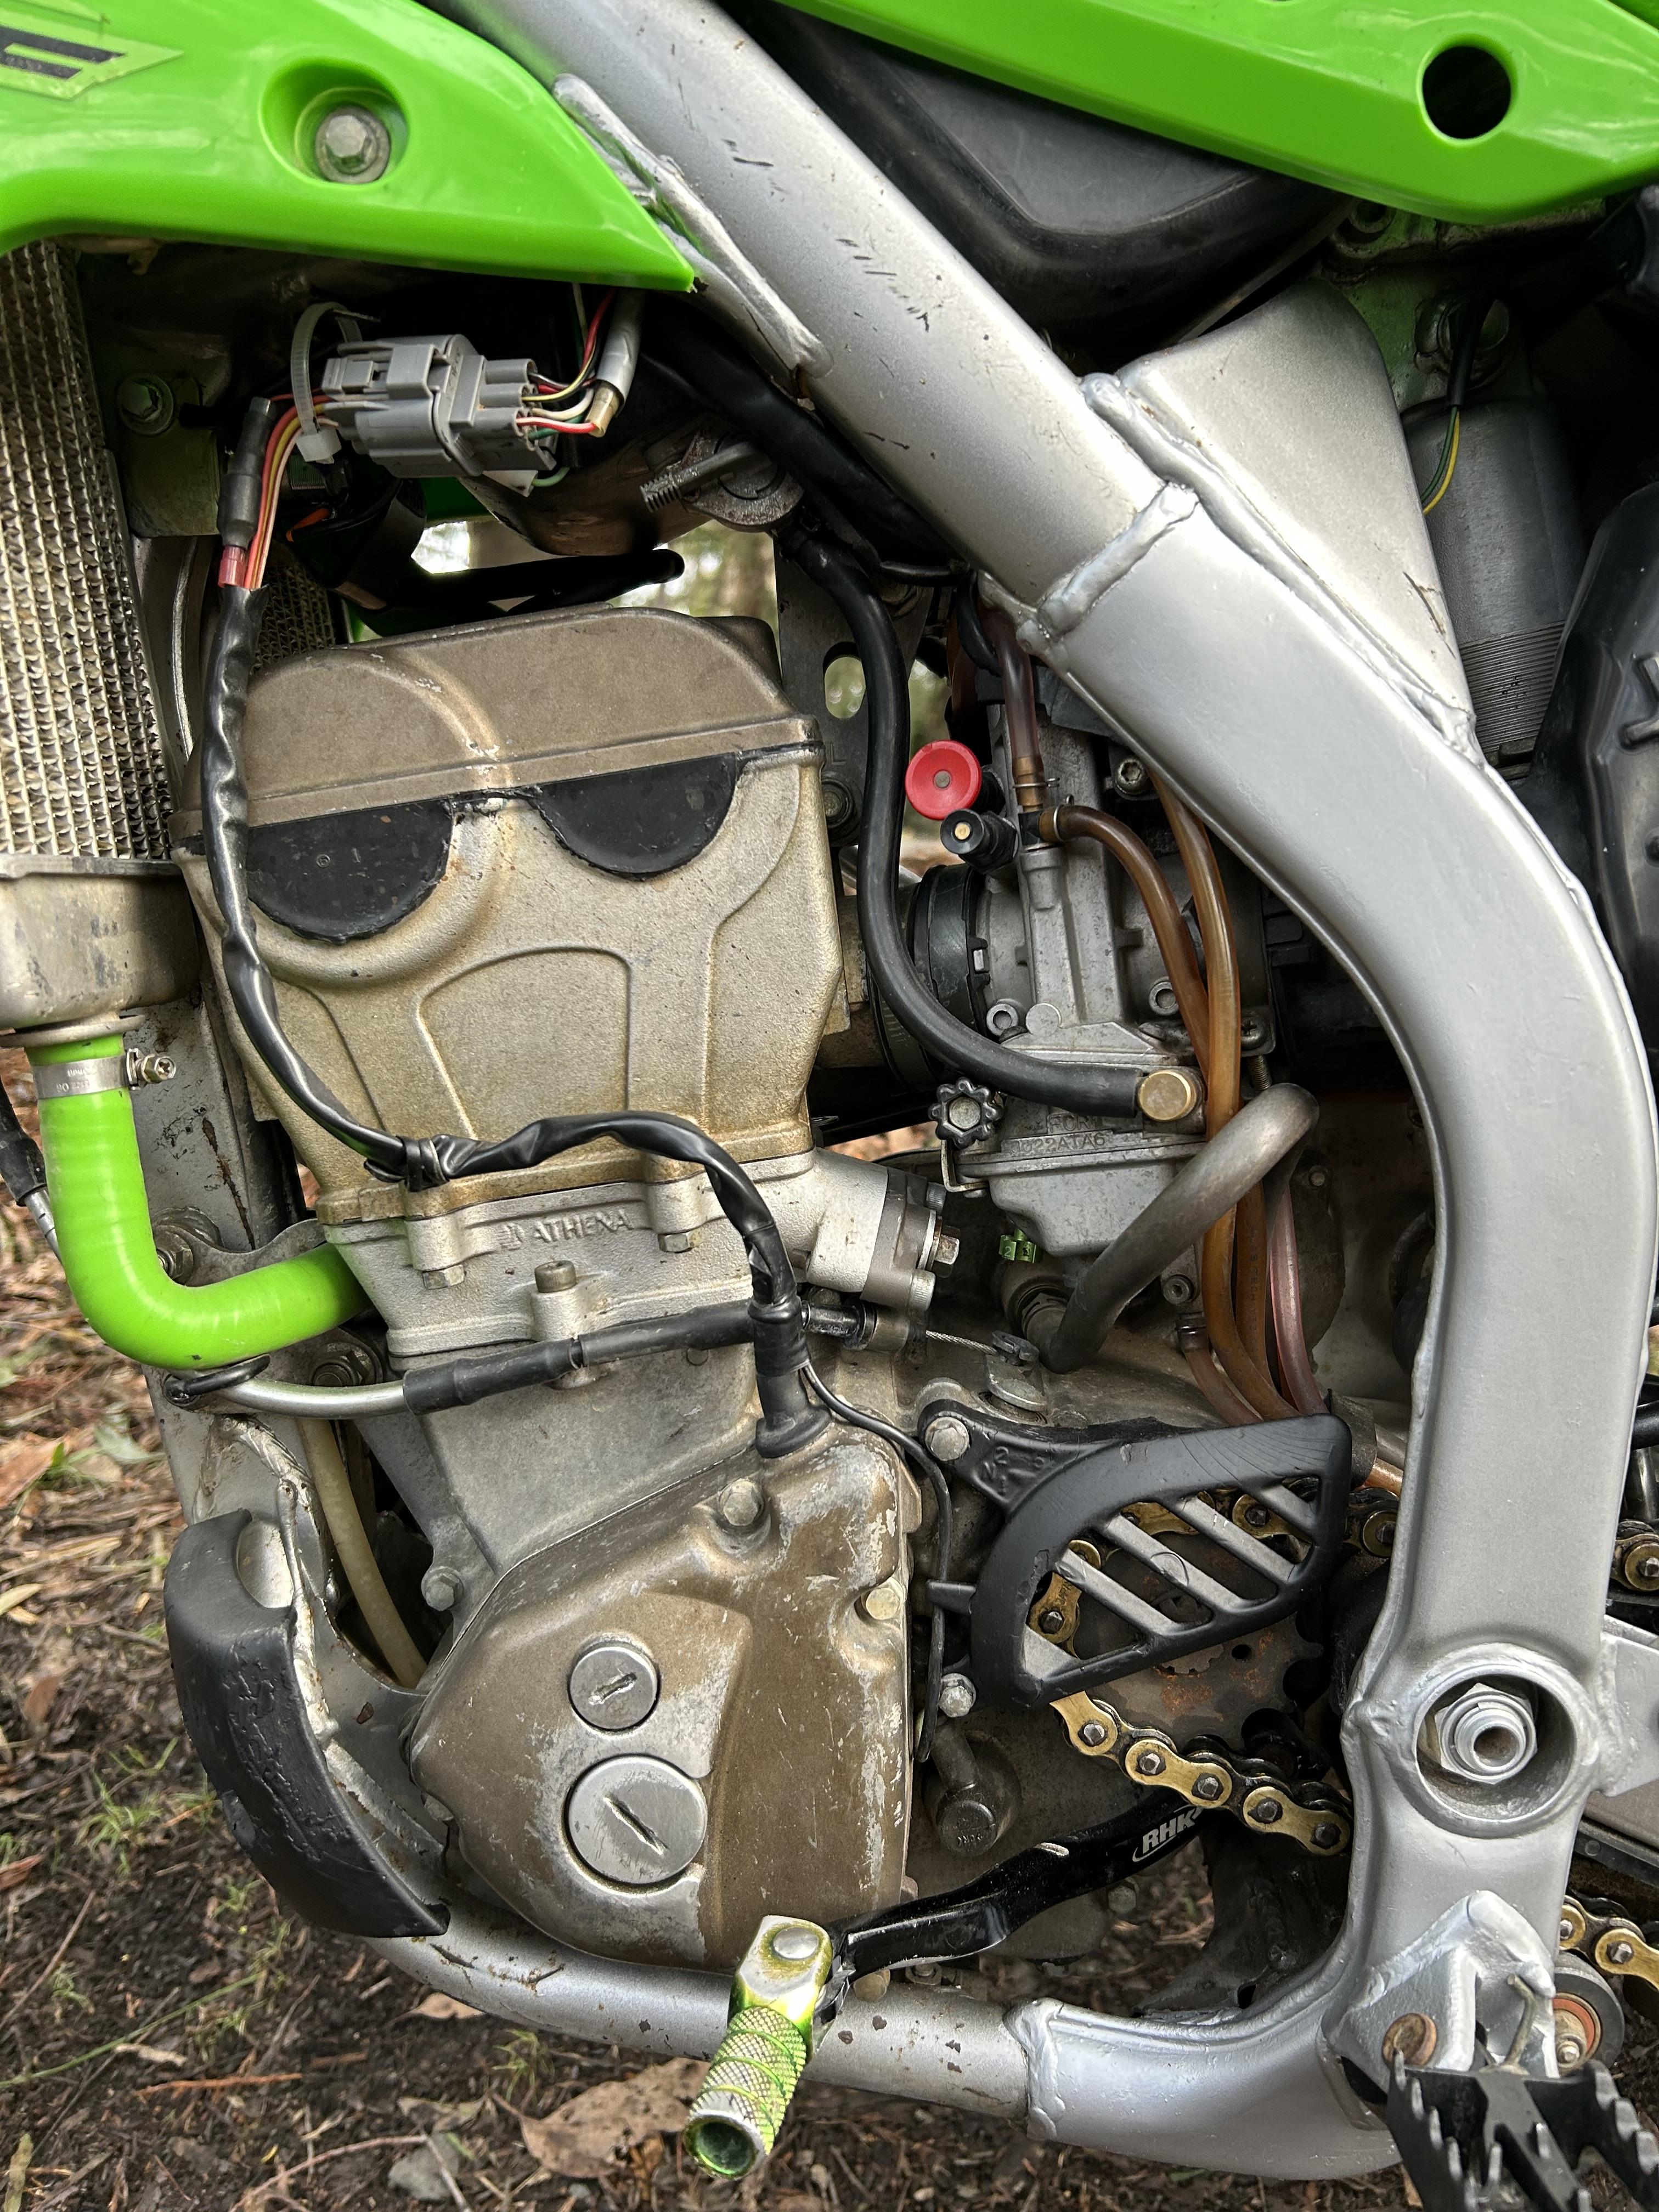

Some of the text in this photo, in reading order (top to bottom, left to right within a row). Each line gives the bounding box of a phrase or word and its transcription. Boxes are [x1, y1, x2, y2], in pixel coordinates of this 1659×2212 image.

[1048, 1114, 1091, 1133] FCR
[533, 1209, 635, 1243] ATHENA
[1003, 1246, 1012, 1257] 2
[1142, 1808, 1196, 1854] RHK
